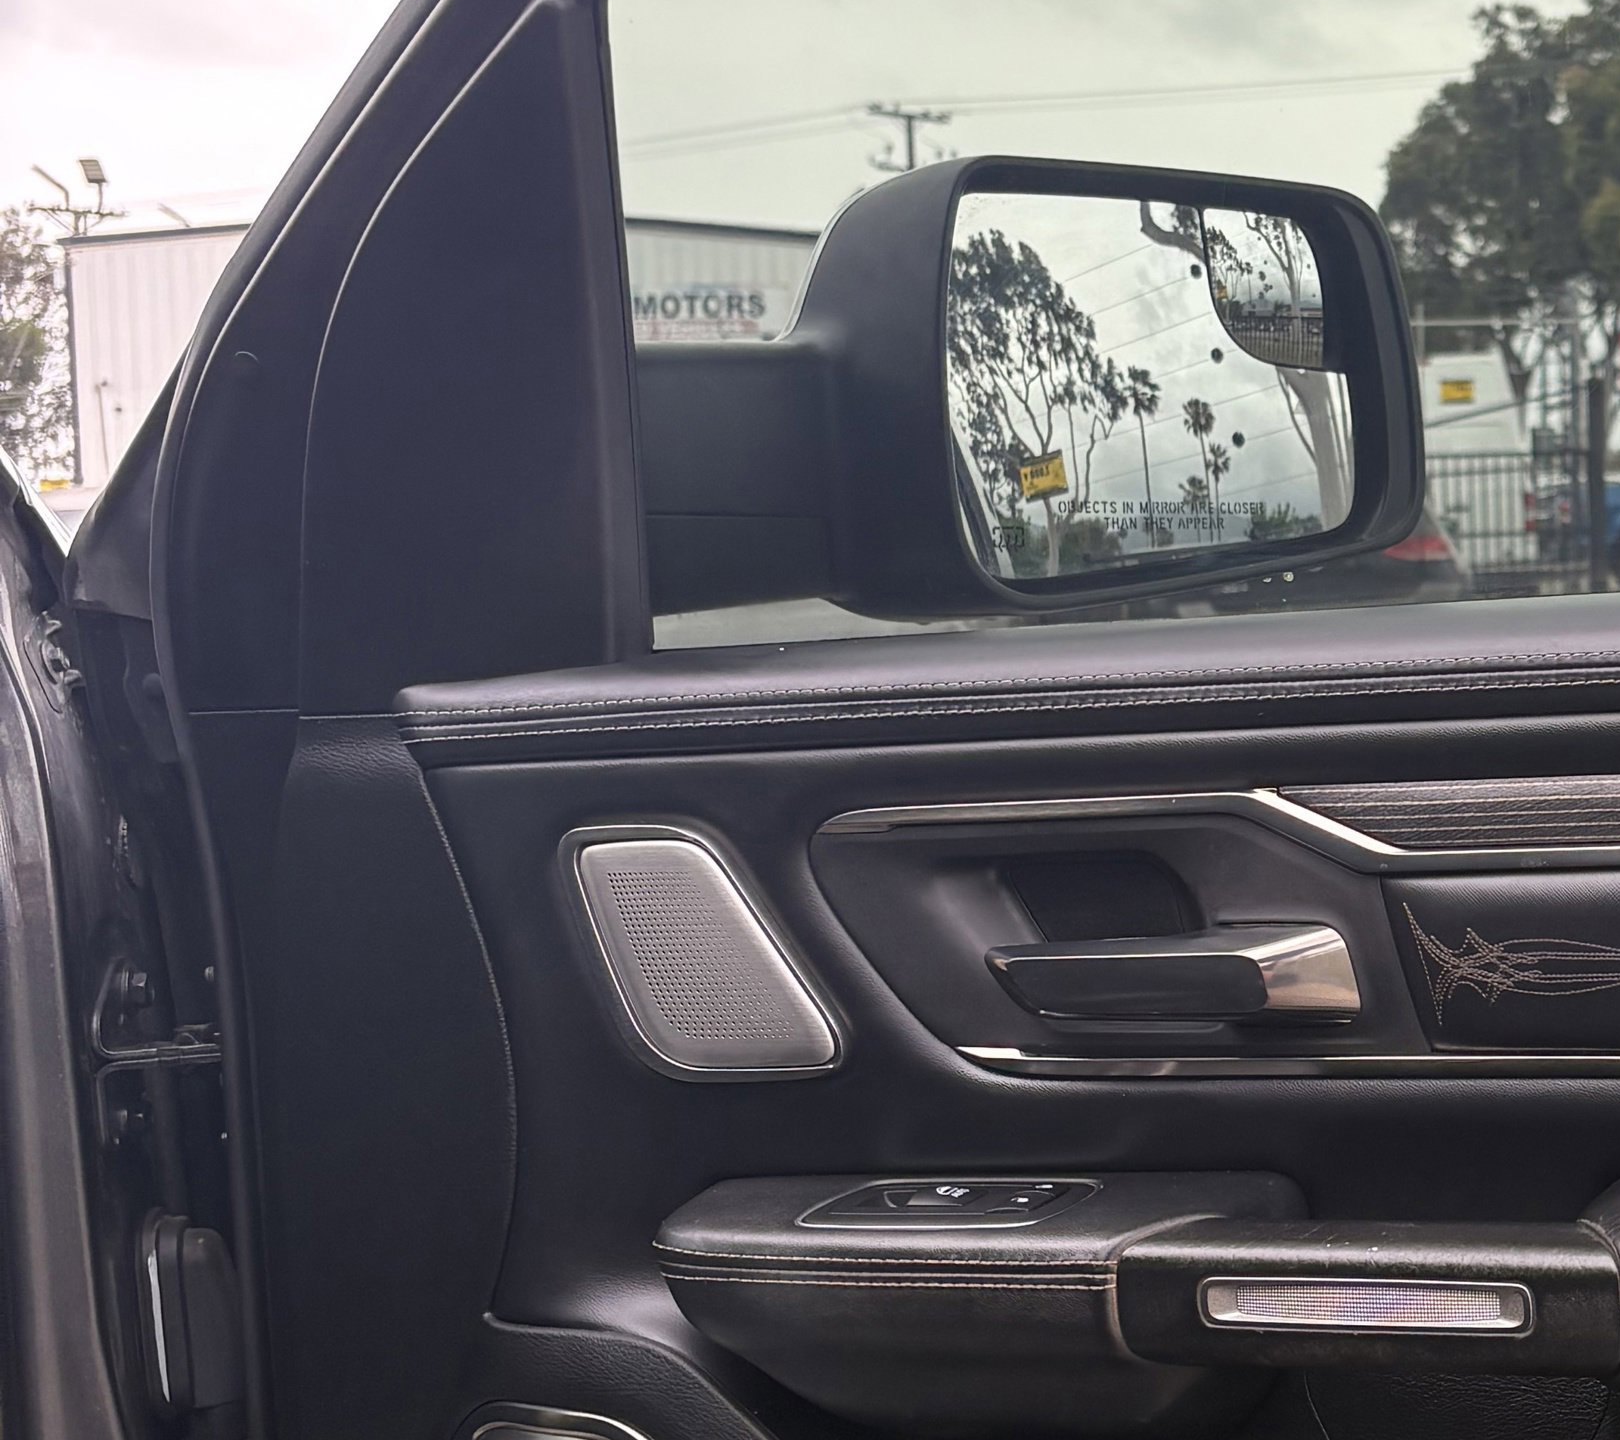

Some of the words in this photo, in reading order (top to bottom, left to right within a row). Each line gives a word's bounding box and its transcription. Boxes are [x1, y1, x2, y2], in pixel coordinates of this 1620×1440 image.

[633, 293, 765, 320] MOTORS
[1057, 500, 1118, 515] OBJECTS
[1122, 500, 1135, 515] IN
[1139, 500, 1186, 515] MIRROR
[1191, 500, 1214, 515] ARE
[1218, 500, 1265, 515] CLOSER
[1103, 516, 1138, 530] THAN
[1143, 516, 1174, 530] THEY
[1177, 516, 1225, 530] APPEAR
